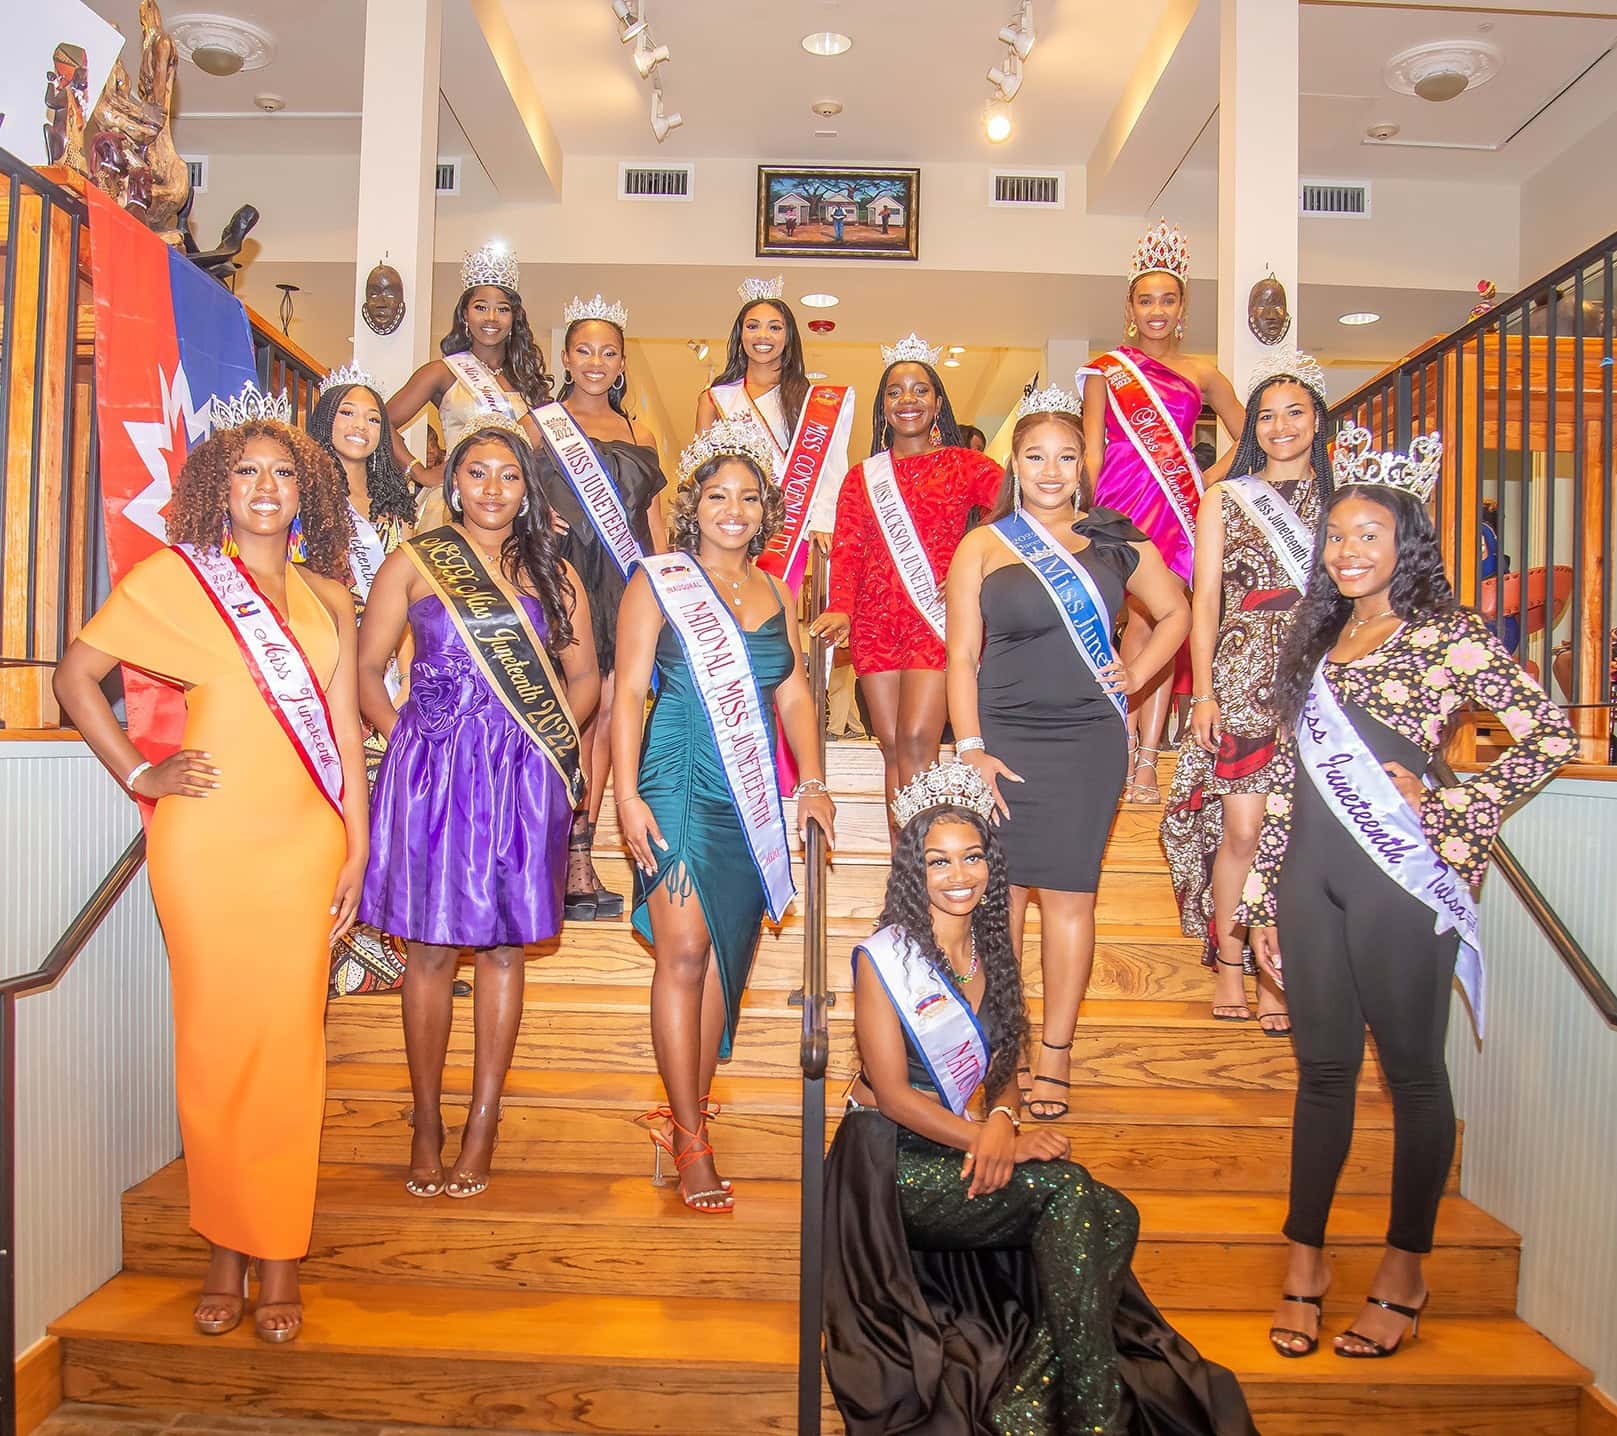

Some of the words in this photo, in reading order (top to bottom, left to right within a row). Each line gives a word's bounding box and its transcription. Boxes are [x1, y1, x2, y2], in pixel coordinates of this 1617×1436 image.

[473, 386, 503, 413] Junet
[553, 427, 575, 442] 2022
[802, 419, 830, 452] MISS
[562, 442, 594, 475] MISS
[580, 473, 638, 564] JUNETEENTH
[1130, 407, 1160, 453] Miss
[1160, 458, 1197, 537] Juneteen
[879, 502, 914, 555] JACKSON
[900, 547, 946, 622] JUNETEENTH
[1252, 494, 1275, 516] Miss
[1268, 513, 1311, 562] Juneteenth
[462, 582, 498, 620] Miss
[1036, 556, 1086, 616] Miss
[474, 627, 545, 705] Juneteenth
[679, 600, 735, 678] NATIONAL
[253, 628, 292, 680] Miss
[278, 686, 338, 769] Juneteenth
[525, 698, 577, 759] 2022
[714, 679, 750, 728] MISS
[731, 731, 772, 830] JUNETEENTH
[1303, 693, 1328, 744] iss
[1316, 752, 1419, 865] Juneteenth
[1425, 858, 1467, 921] Tulsa
